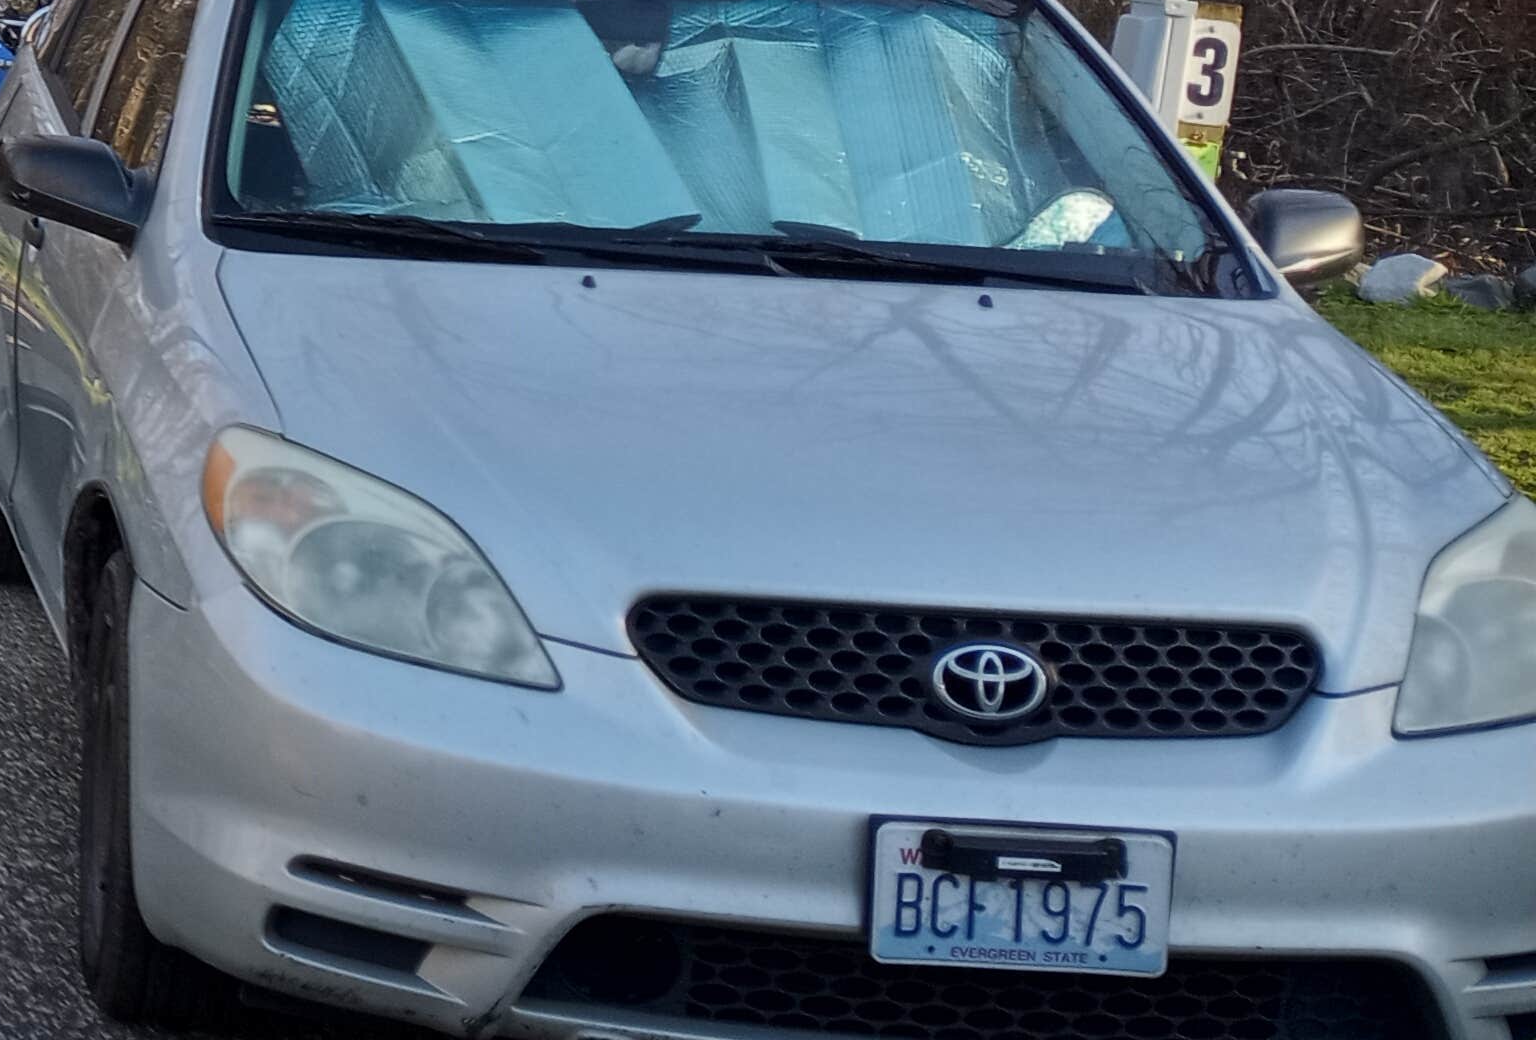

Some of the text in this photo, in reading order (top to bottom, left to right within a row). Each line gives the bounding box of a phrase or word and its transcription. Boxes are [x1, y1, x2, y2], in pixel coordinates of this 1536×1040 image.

[1186, 36, 1229, 107] 3
[895, 872, 1148, 949] BCF1975
[950, 946, 1089, 965] EVERGREEN STATE
